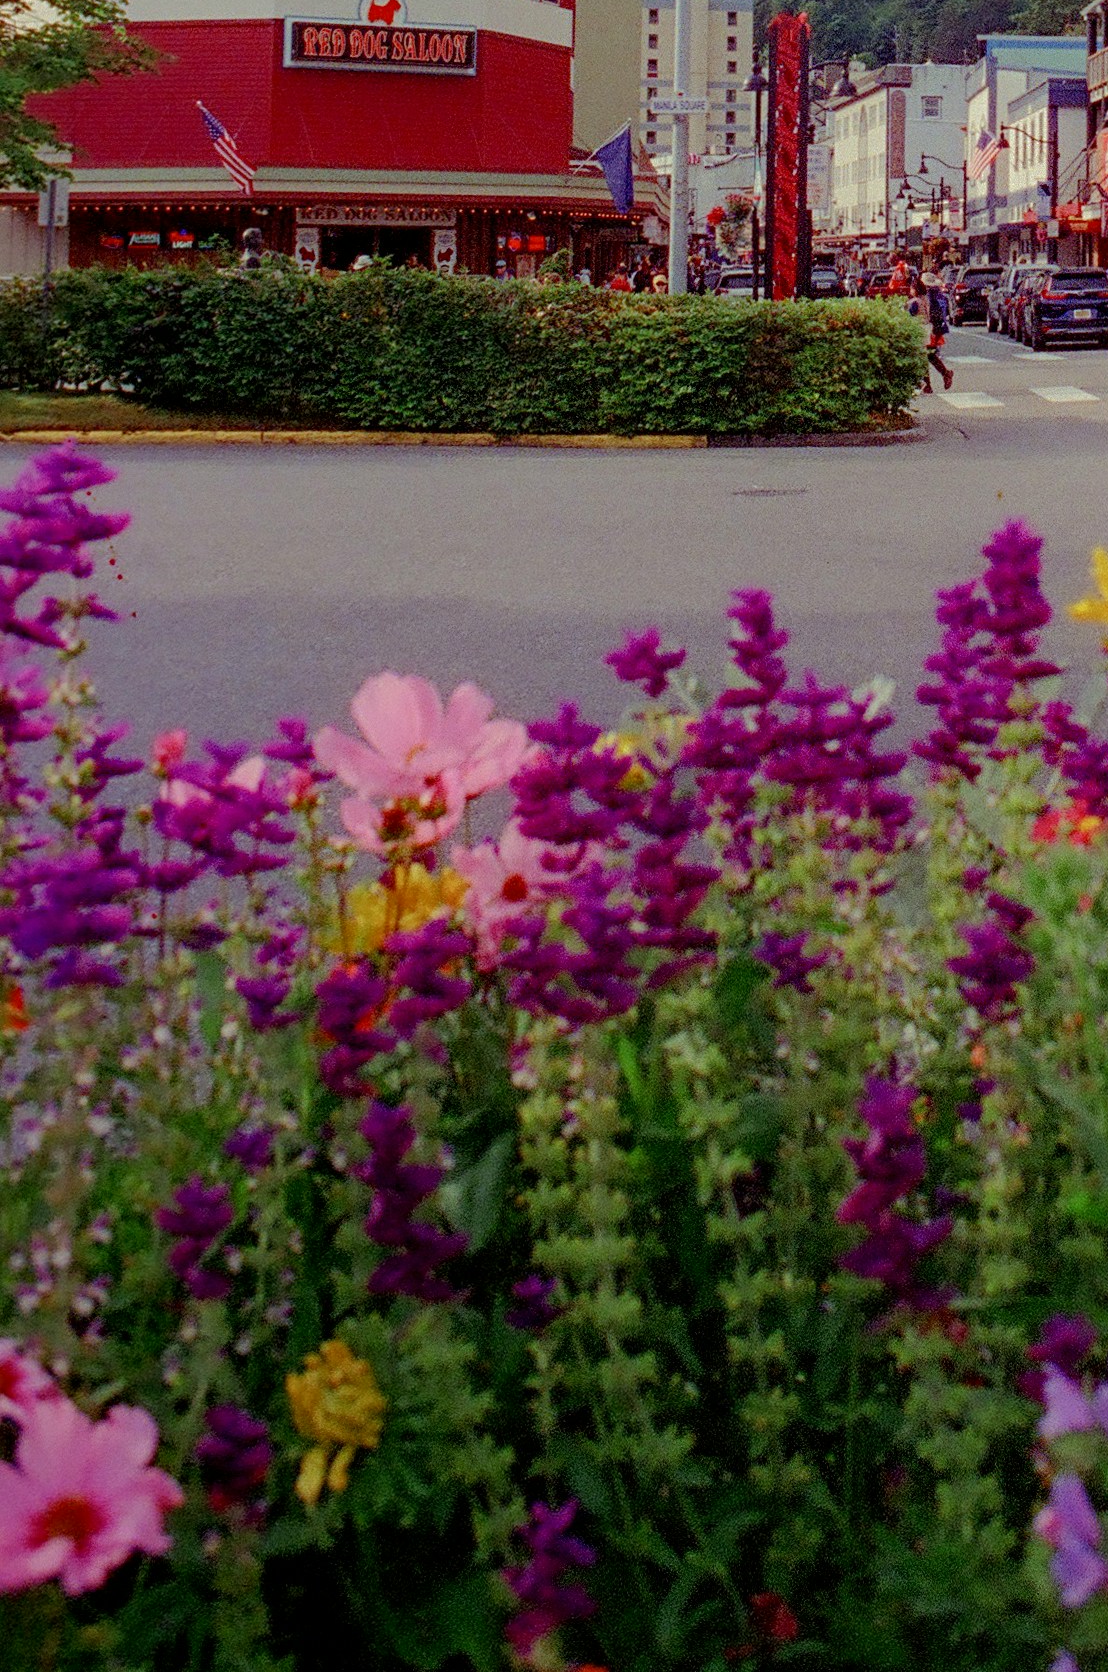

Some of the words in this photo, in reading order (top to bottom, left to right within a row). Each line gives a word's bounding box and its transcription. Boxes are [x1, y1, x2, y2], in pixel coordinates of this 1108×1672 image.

[303, 27, 346, 57] RED
[350, 29, 389, 59] DOG
[391, 31, 468, 63] SALOON
[653, 100, 677, 111] MANILA
[680, 100, 705, 111] SQUARE
[301, 208, 338, 220] RED
[345, 208, 378, 221] DOG
[385, 209, 451, 222] SALOON
